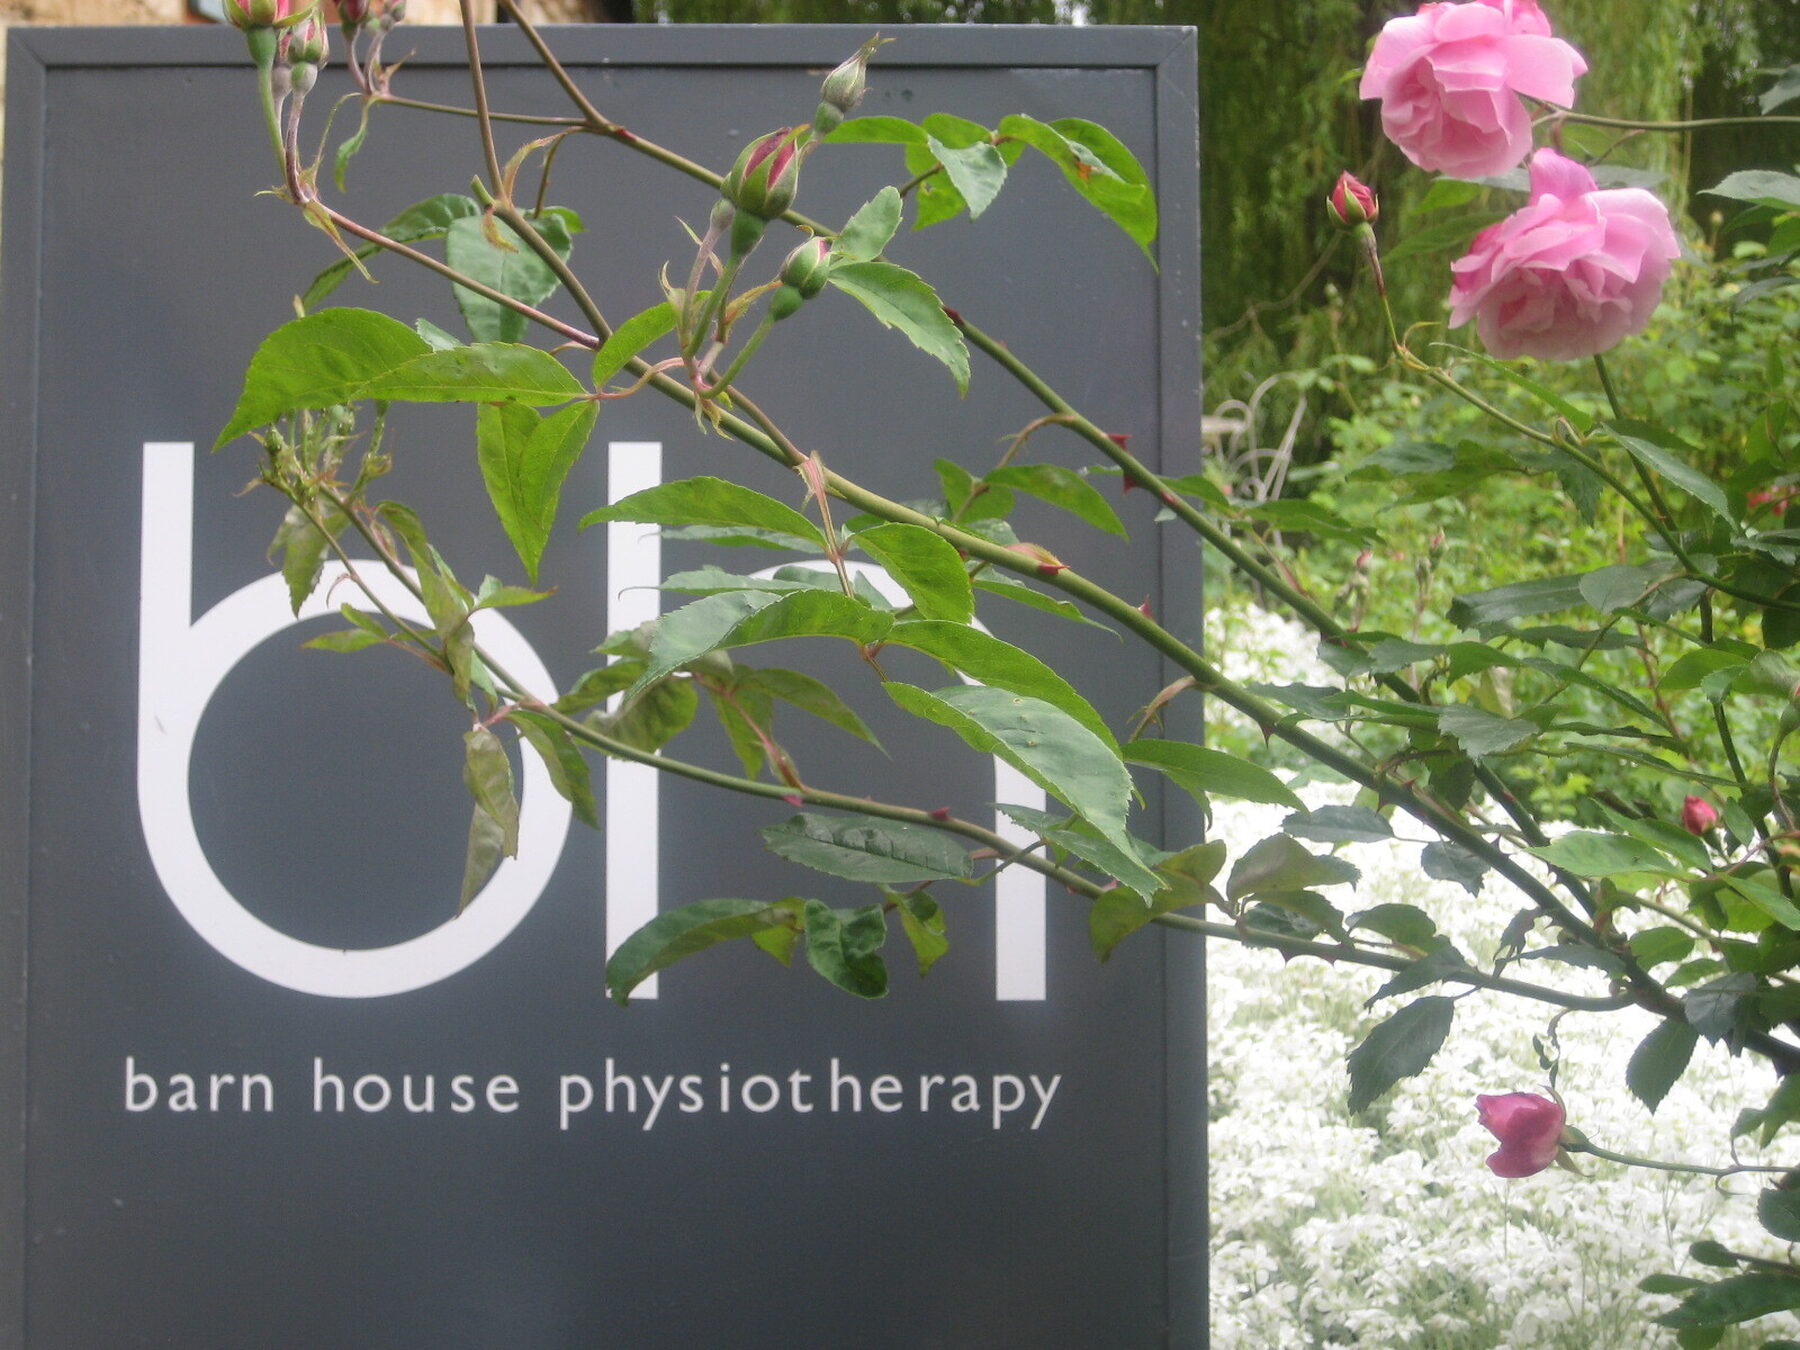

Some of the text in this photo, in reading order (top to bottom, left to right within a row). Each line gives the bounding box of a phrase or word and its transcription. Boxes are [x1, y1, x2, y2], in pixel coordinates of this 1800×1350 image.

[137, 442, 1047, 1001] bh
[124, 1056, 1062, 1132] barn house physiotherapy
